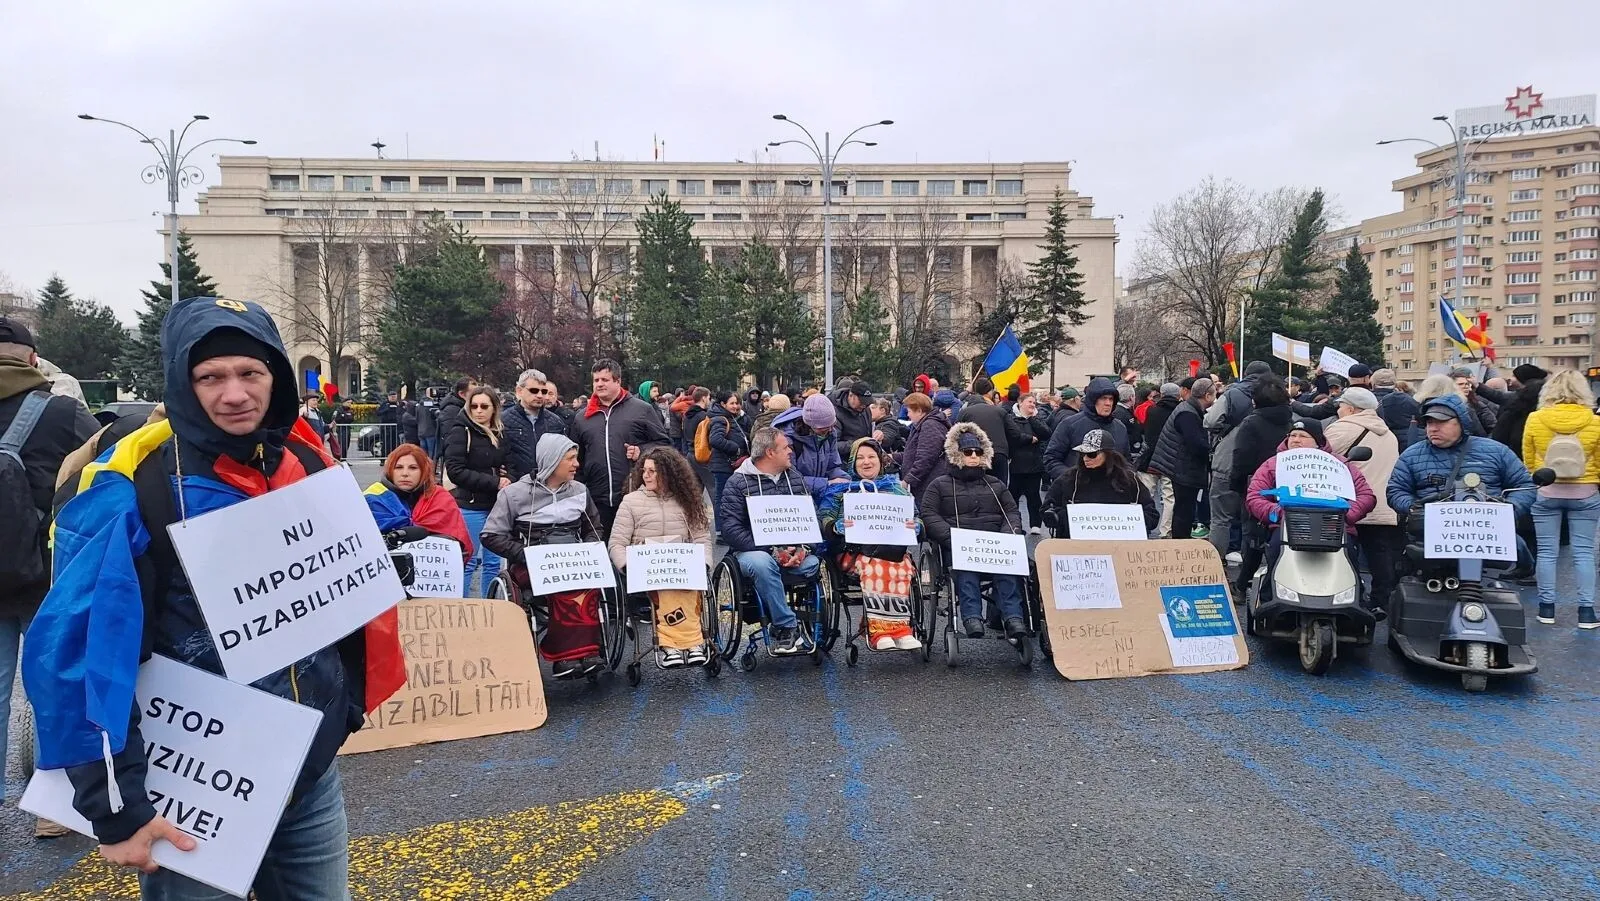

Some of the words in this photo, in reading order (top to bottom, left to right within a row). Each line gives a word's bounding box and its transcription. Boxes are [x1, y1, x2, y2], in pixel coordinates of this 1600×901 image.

[1459, 121, 1523, 138] REGINA
[1531, 114, 1590, 131] MARIA
[1299, 483, 1342, 492] ECTATE!
[765, 507, 800, 515] INDEXAȚI
[854, 504, 904, 513] ACTUALIZAȚI
[1440, 507, 1498, 516] SCUMPIRI
[754, 516, 814, 524] INDEMNIZAȚIILE
[1071, 515, 1124, 523] DREPTURI,
[1444, 520, 1495, 529] ZILNICE,
[282, 518, 314, 546] NU
[1441, 533, 1498, 541] VENITURI
[408, 542, 451, 552] ACESTE
[960, 546, 1017, 556] DECIZIILOR
[1434, 544, 1507, 555] BLOCATE!
[544, 550, 590, 559] ANULAȚI
[637, 549, 651, 557] NU
[1127, 551, 1143, 563] UN
[415, 555, 449, 565] ITURI,
[540, 559, 599, 571] CRITERIILE
[967, 556, 1015, 566] ABUZIVE!
[1055, 559, 1070, 572] NU
[233, 532, 363, 605] IMPOZITAȚI
[414, 567, 440, 578] ĂCIA
[444, 570, 450, 578] E
[646, 567, 686, 575] SUNTEM
[542, 571, 605, 585] ABUZIVE!
[646, 577, 689, 585] OAMENI!
[405, 583, 456, 592] ANTATĂ!
[219, 553, 392, 651] DIZABILITATEA!
[1060, 621, 1120, 640] RESPECT
[401, 632, 449, 659] REA
[1115, 637, 1134, 653] NU
[1095, 655, 1135, 675] MILĂ
[406, 657, 497, 691] NELOR
[146, 697, 225, 738] STOP
[146, 742, 255, 802] IZIILOR
[149, 790, 224, 839] ZIVE!
